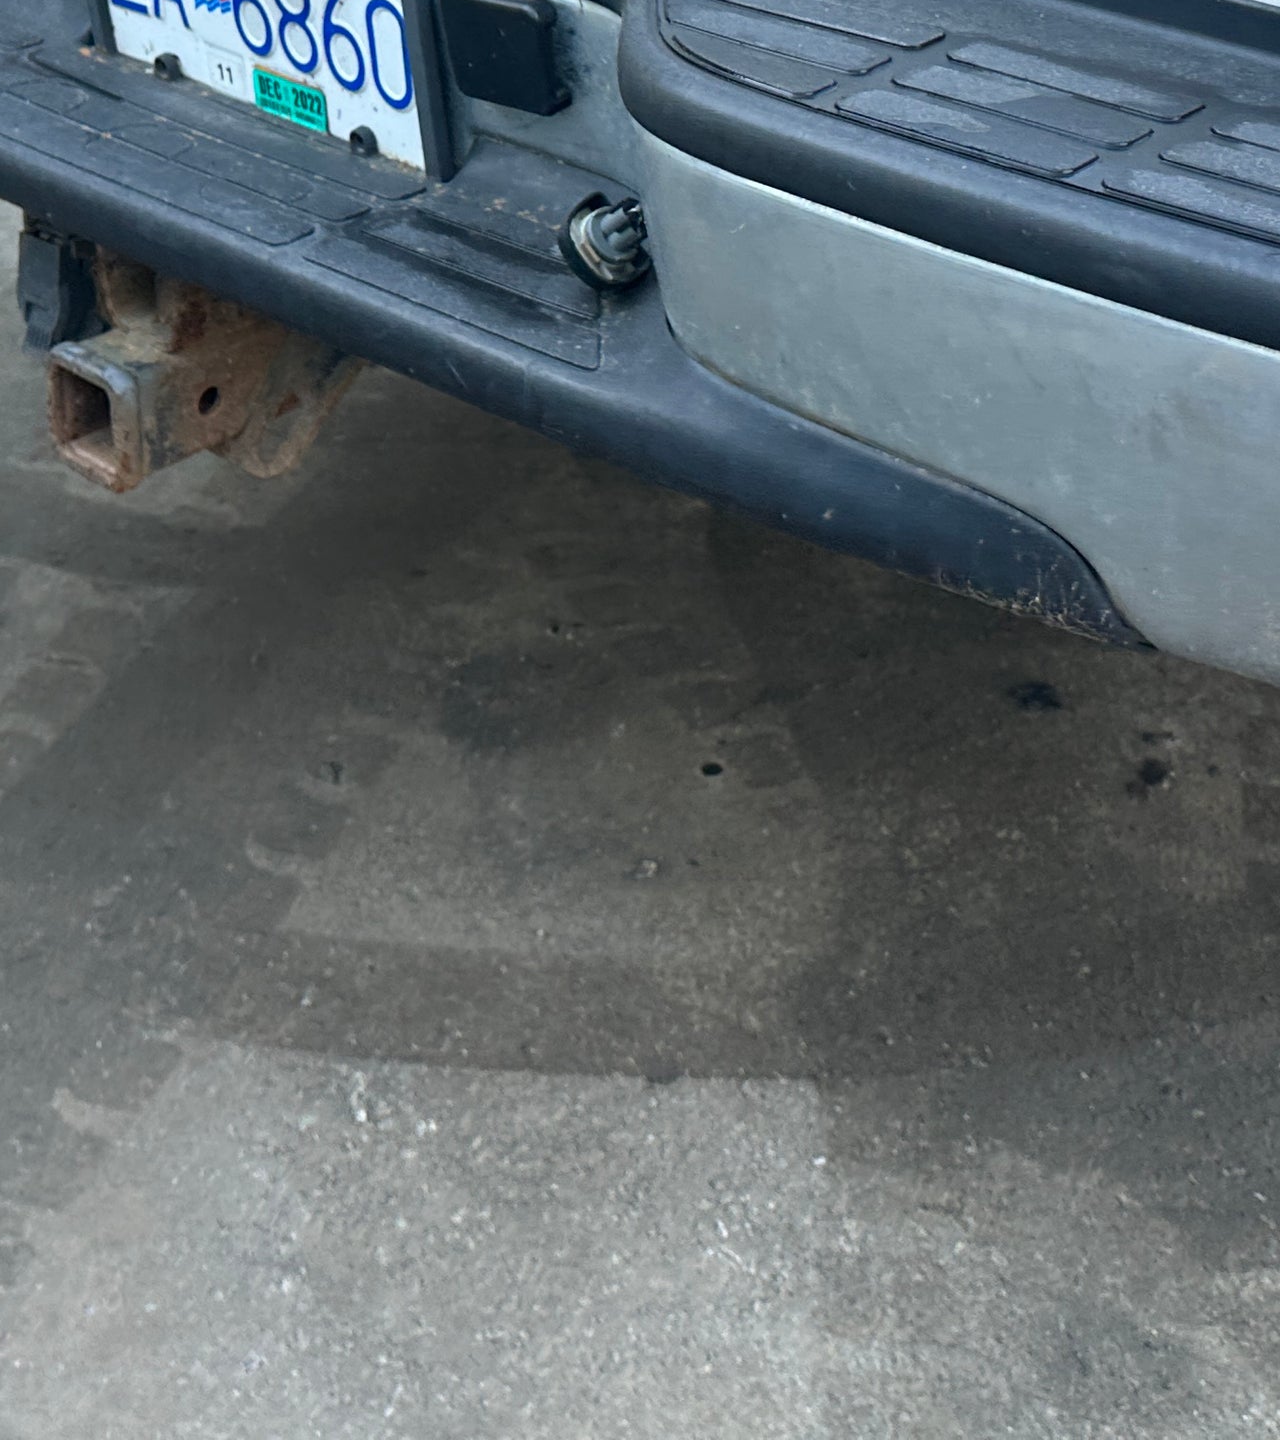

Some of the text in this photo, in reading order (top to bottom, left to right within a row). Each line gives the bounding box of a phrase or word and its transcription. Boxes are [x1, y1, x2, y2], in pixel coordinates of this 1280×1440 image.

[217, 64, 233, 85] 11
[258, 74, 282, 101] DEC
[291, 87, 323, 116] 2022
